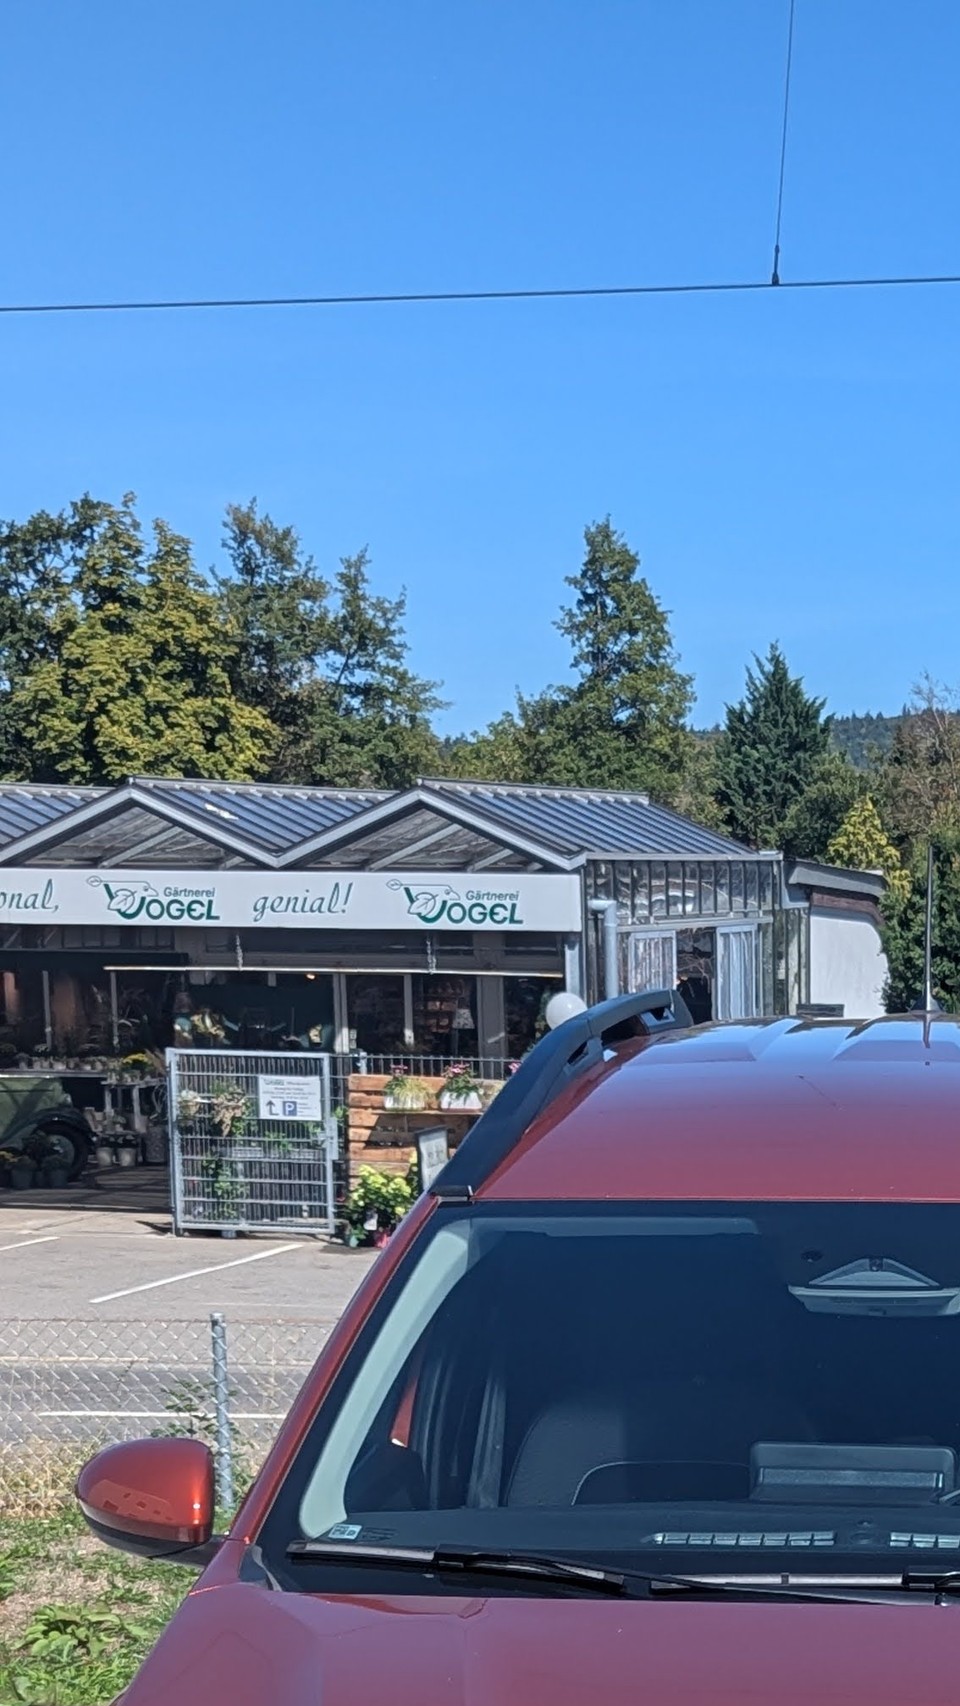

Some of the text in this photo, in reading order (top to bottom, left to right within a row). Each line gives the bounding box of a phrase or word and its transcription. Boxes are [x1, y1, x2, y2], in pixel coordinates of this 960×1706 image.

[103, 883, 220, 920] VOGEL
[163, 886, 216, 898] Gärtnerei
[253, 882, 354, 922] genial!
[403, 887, 524, 924] VOGEL
[465, 890, 520, 901] Gärtnerei
